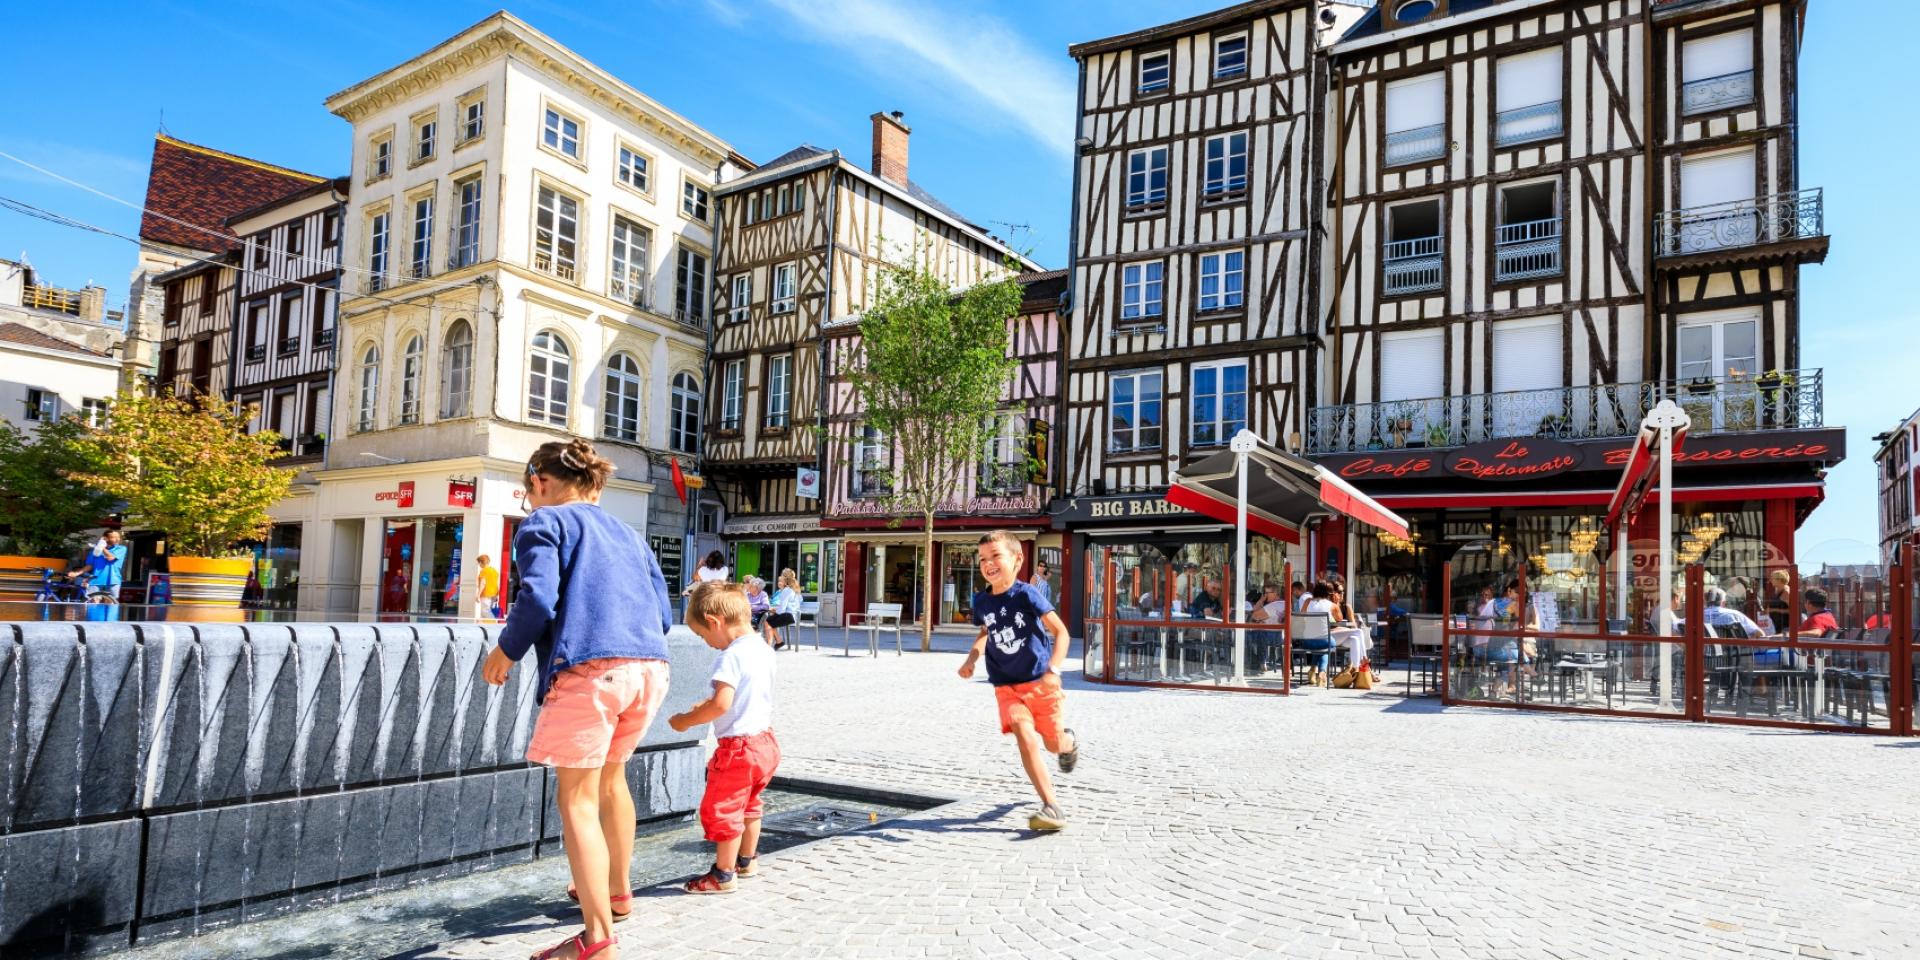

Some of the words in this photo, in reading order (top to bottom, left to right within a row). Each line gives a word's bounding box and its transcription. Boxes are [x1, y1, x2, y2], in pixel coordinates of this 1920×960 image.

[1495, 442, 1529, 459] Le
[1602, 443, 1828, 465] Basserie
[1339, 459, 1431, 478] Café
[1453, 455, 1574, 479] Diplomate
[375, 491, 398, 501] espace
[399, 489, 413, 499] SFR
[454, 490, 473, 500] SFR
[1090, 501, 1125, 517] BIG
